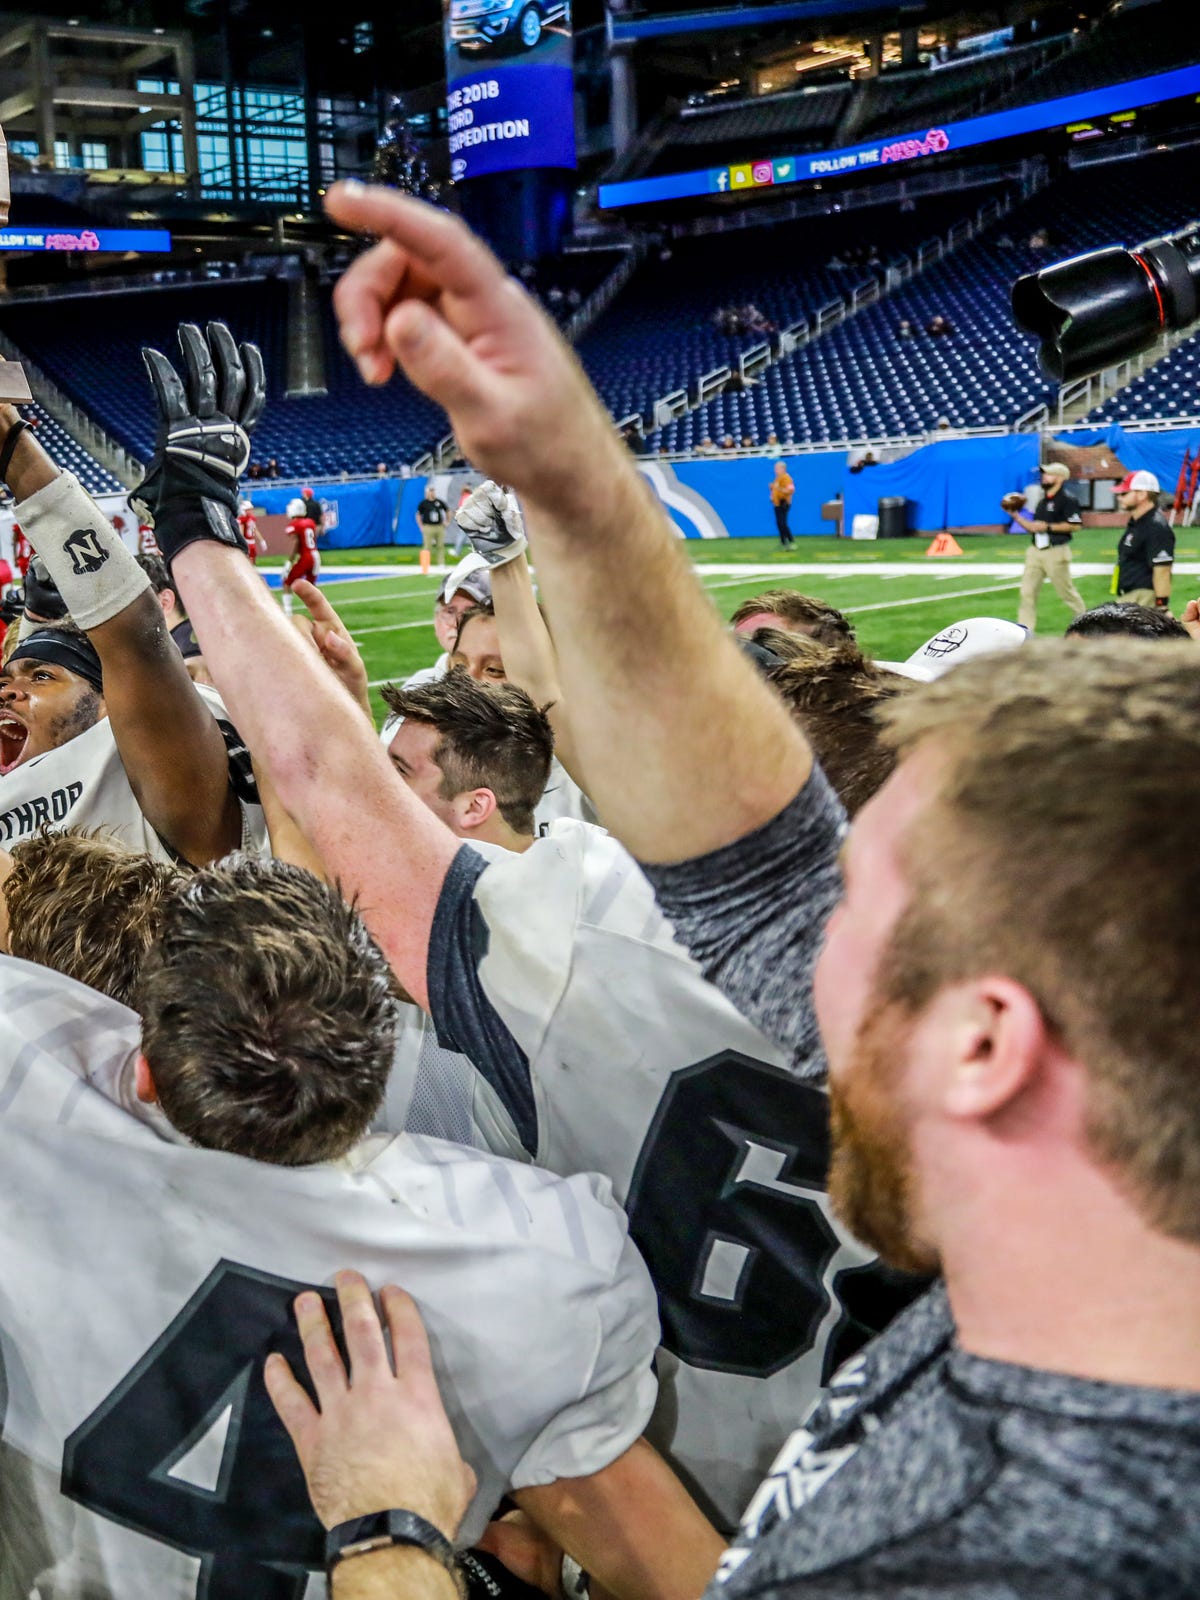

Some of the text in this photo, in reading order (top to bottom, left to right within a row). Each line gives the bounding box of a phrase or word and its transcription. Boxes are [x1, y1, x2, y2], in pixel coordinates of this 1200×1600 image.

[462, 80, 499, 105] 2018
[810, 155, 857, 174] FOLLOW
[859, 149, 879, 164] THE
[627, 1048, 890, 1385] 6
